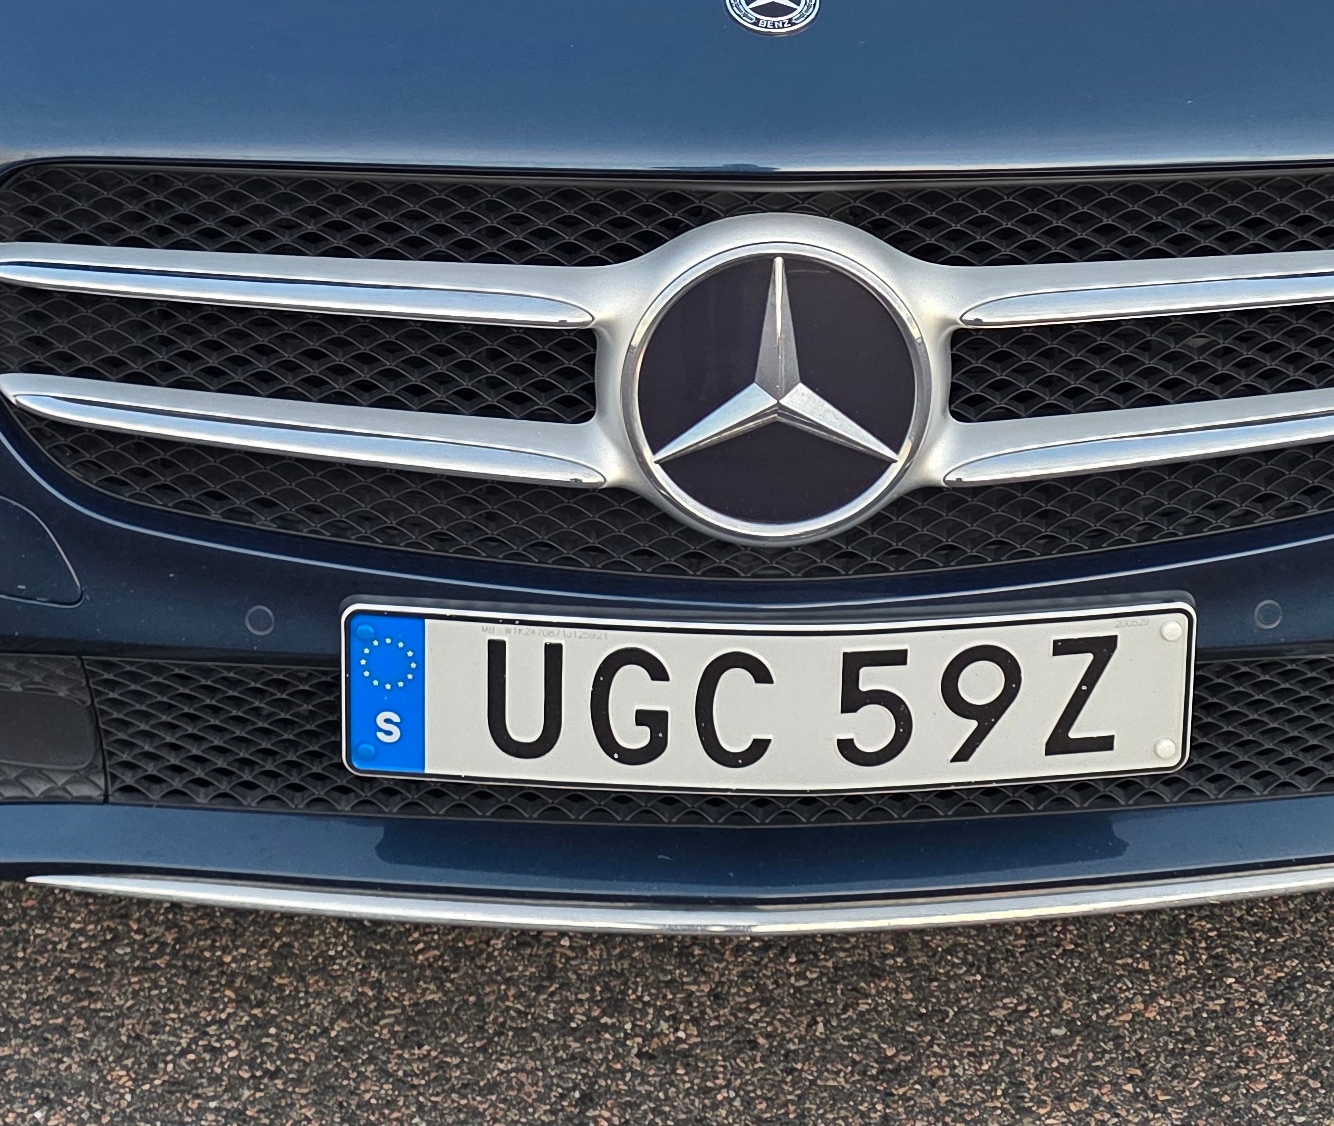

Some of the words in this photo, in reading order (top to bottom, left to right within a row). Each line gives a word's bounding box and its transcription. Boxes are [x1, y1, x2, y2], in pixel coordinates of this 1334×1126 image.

[758, 19, 792, 29] BENZ
[487, 639, 774, 768] UGC
[836, 635, 1119, 767] 59Z
[376, 711, 401, 743] S
